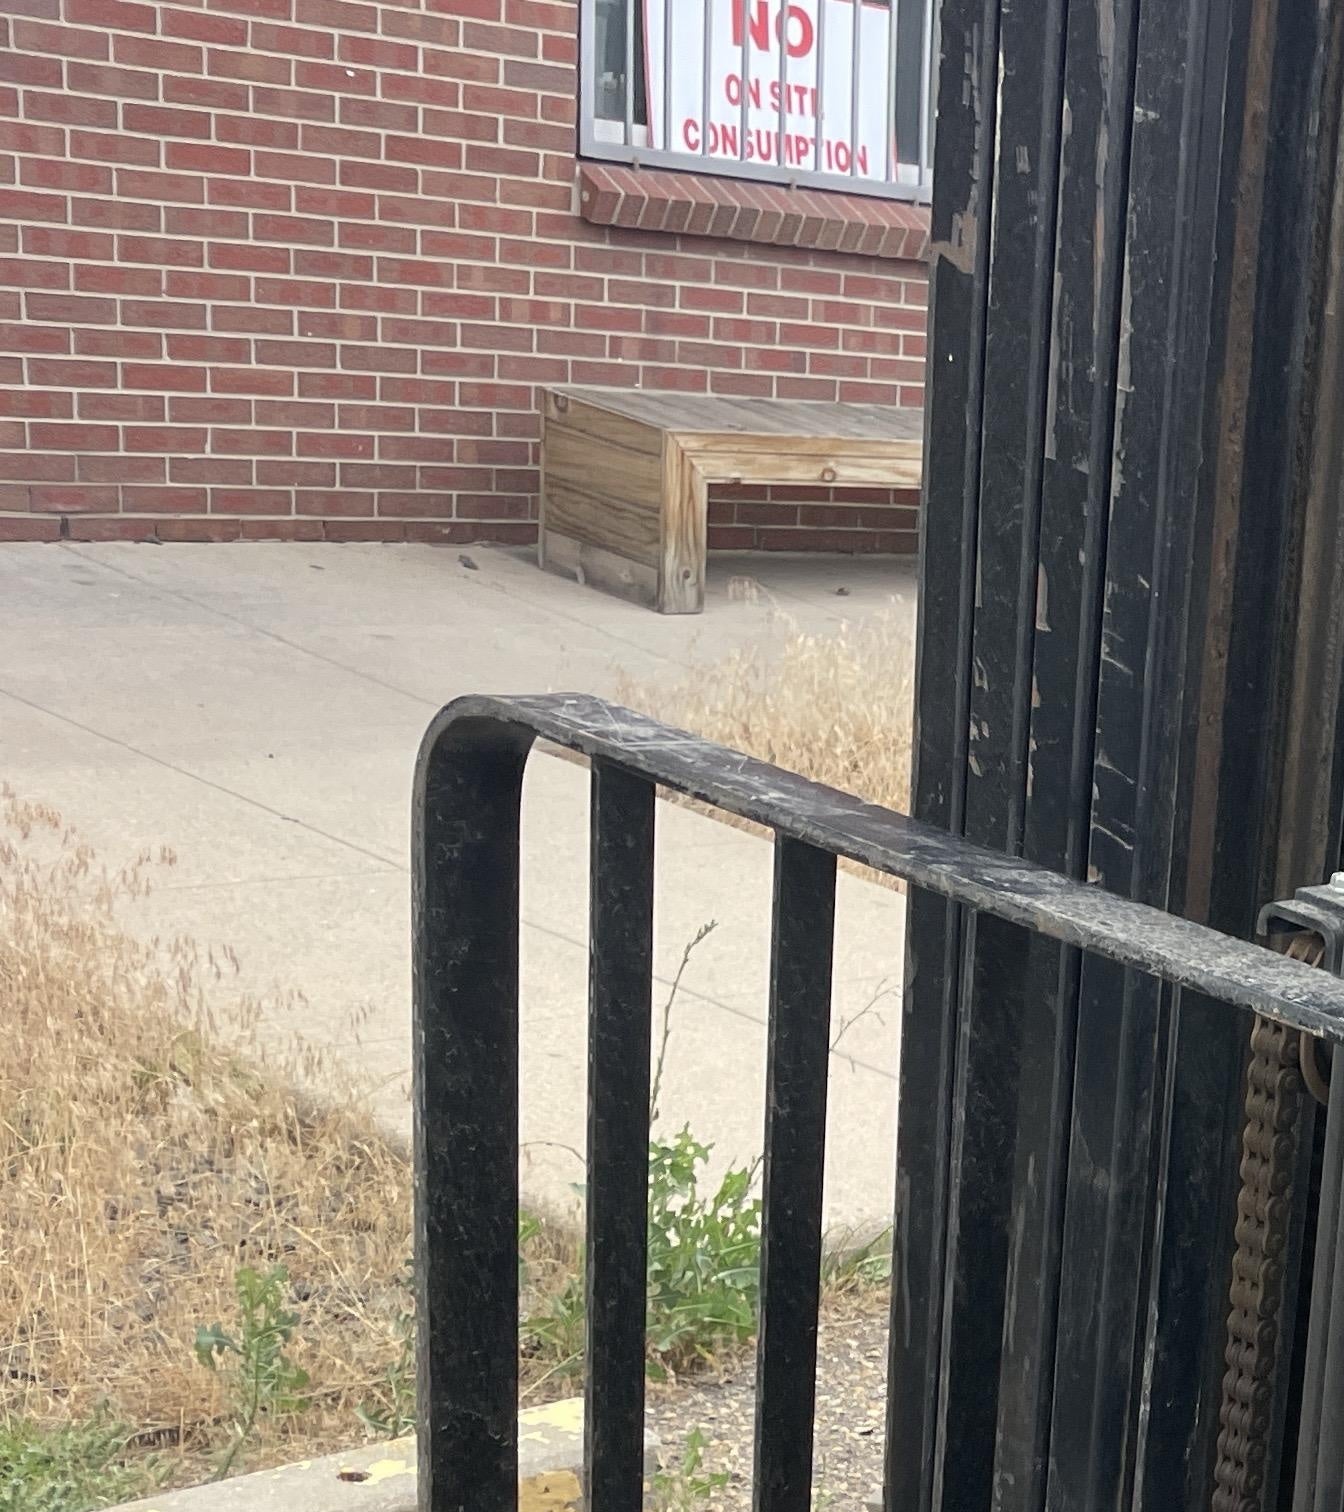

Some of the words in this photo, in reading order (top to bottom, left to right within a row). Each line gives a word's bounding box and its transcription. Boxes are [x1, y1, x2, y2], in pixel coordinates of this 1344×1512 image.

[731, 0, 814, 58] NO
[725, 73, 761, 109] ON
[683, 118, 868, 175] CONSUMPION
